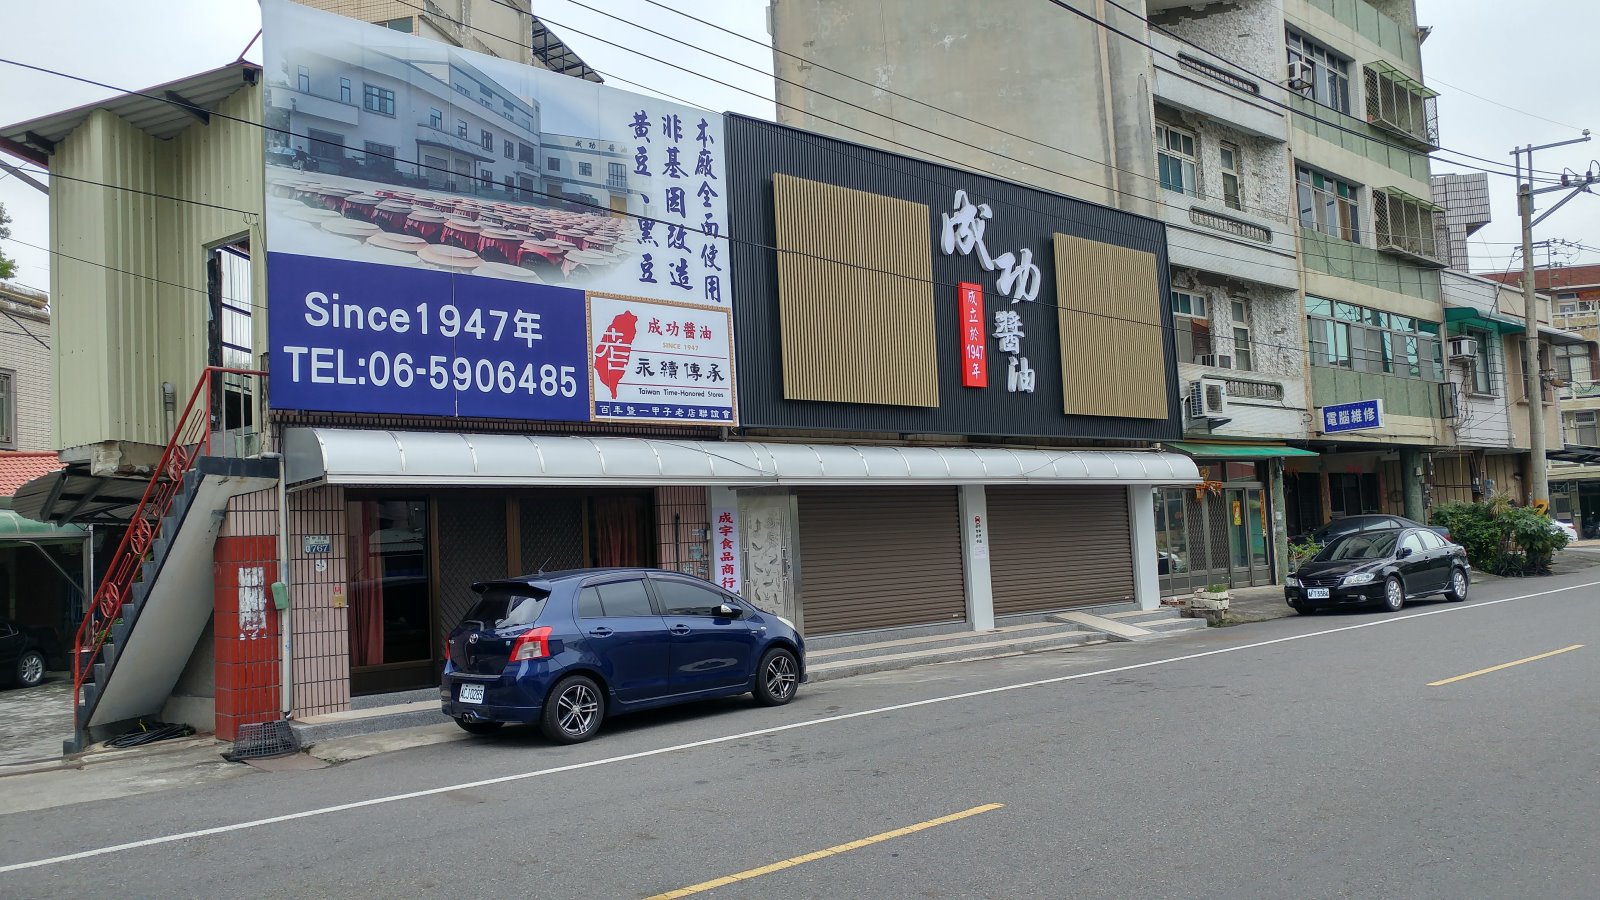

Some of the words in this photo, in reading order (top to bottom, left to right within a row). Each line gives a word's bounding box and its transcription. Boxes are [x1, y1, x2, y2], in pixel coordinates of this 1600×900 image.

[647, 317, 712, 340] 成功醬油
[283, 345, 577, 397] TEL:06-5906485
[636, 358, 725, 382] 永續傳承
[638, 387, 660, 396] Taiwan
[663, 388, 705, 397] Time-Honored
[707, 390, 724, 398] Stores
[1326, 407, 1375, 426] 電腦維修
[312, 544, 329, 553] 767
[718, 512, 736, 589] 成宇食品商行
